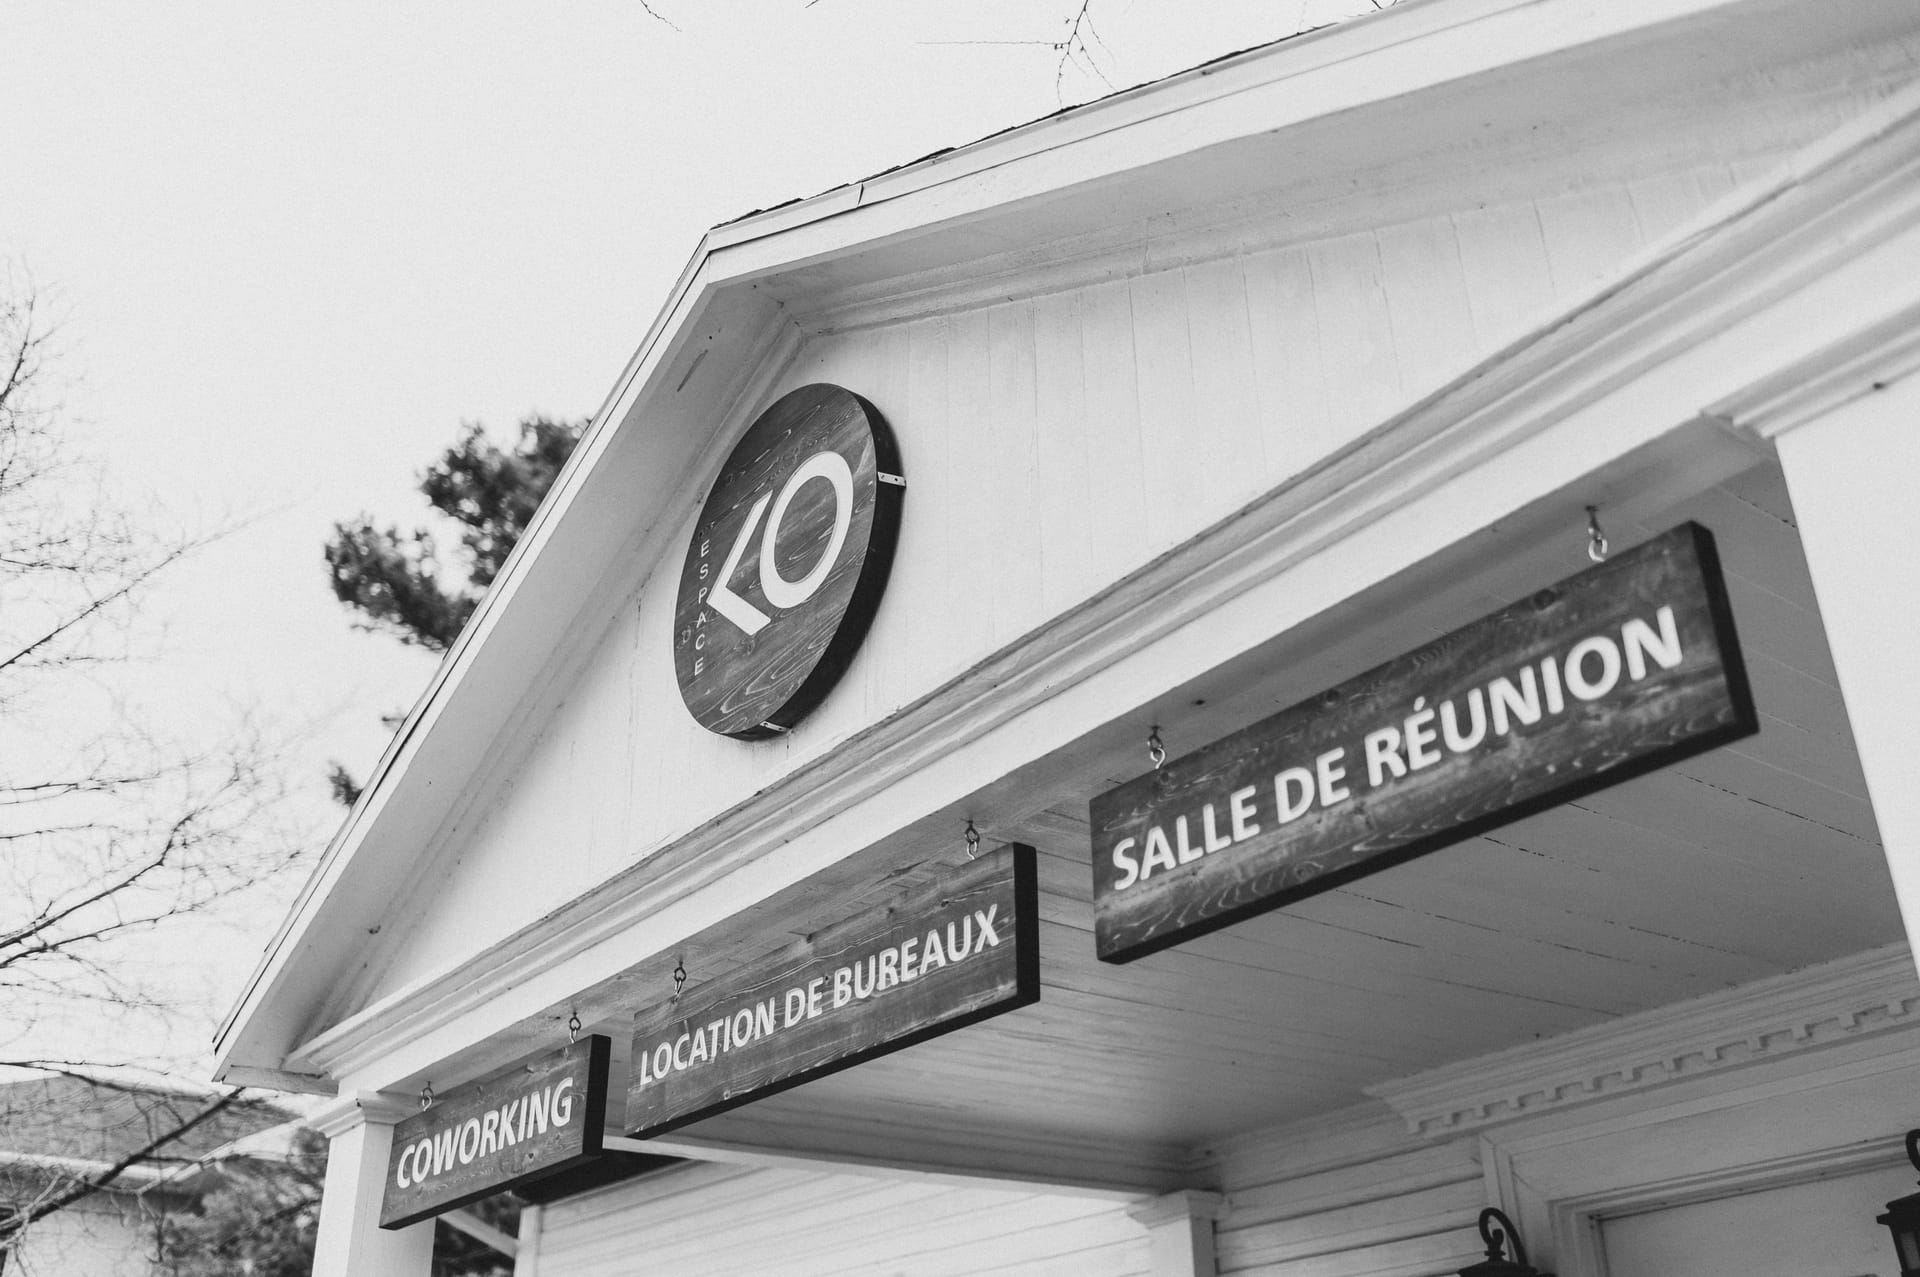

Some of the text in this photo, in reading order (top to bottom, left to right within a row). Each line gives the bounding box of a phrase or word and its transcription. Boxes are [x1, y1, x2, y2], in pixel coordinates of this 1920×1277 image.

[694, 539, 710, 676] ESPACE
[1112, 605, 1683, 891] SALLE DE RÉUNION
[639, 904, 1000, 1087] LOCATION DE BUREAUX
[397, 1077, 574, 1189] COWORKING
